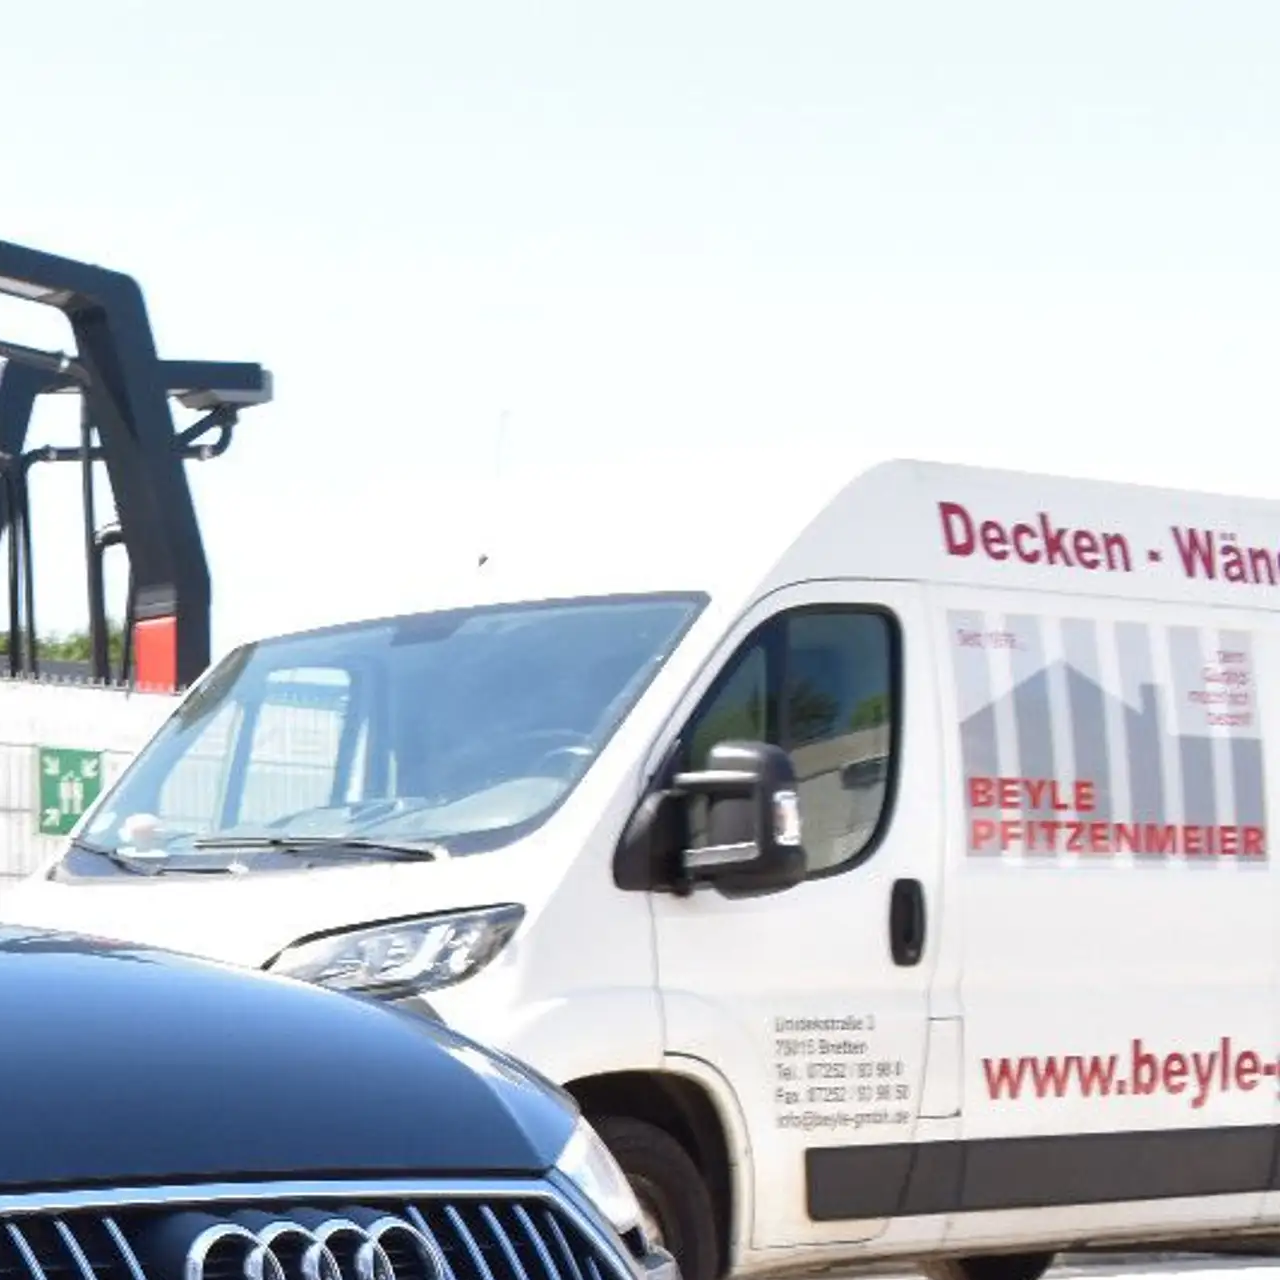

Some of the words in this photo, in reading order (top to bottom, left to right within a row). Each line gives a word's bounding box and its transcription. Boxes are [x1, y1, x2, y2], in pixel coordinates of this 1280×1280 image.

[939, 501, 1132, 571] Decken
[1171, 525, 1280, 586] Wän
[969, 777, 1095, 812] BEYLE
[971, 820, 1265, 856] PFITZENMEIER
[981, 1036, 1280, 1108] www.beyle-
